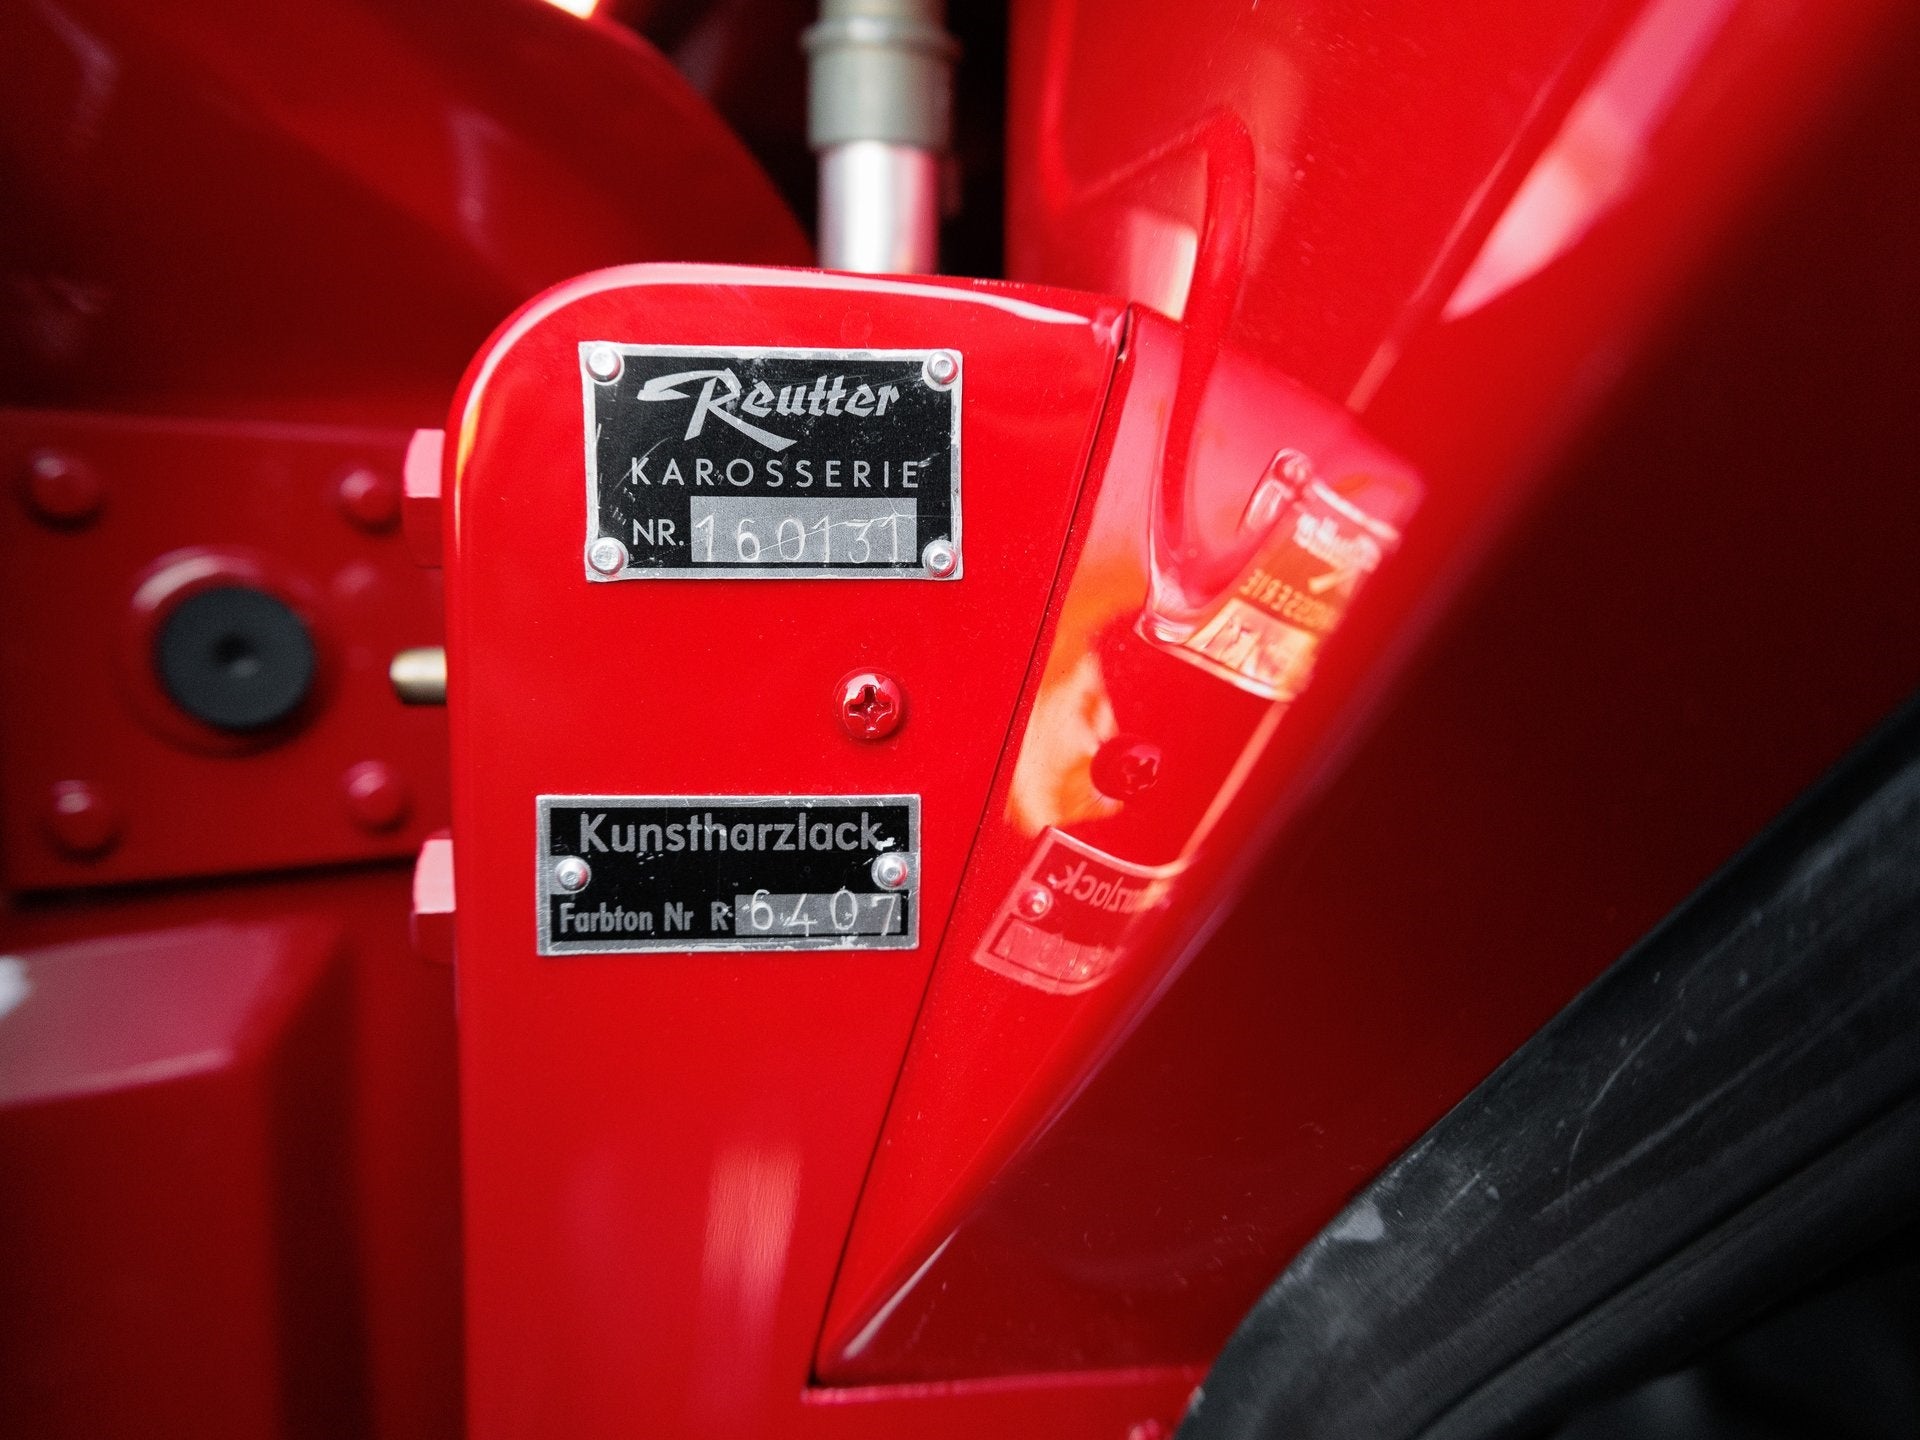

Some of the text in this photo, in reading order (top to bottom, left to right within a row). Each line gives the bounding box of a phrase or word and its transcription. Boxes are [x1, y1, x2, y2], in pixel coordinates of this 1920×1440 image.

[637, 367, 900, 452] Reutter
[631, 457, 919, 488] KAROSSERIE
[632, 513, 901, 564] NR. 160131
[580, 812, 883, 853] Kunstharzlack
[559, 902, 654, 934] Farbton
[664, 901, 694, 933] Nr
[750, 888, 898, 938] 6407
